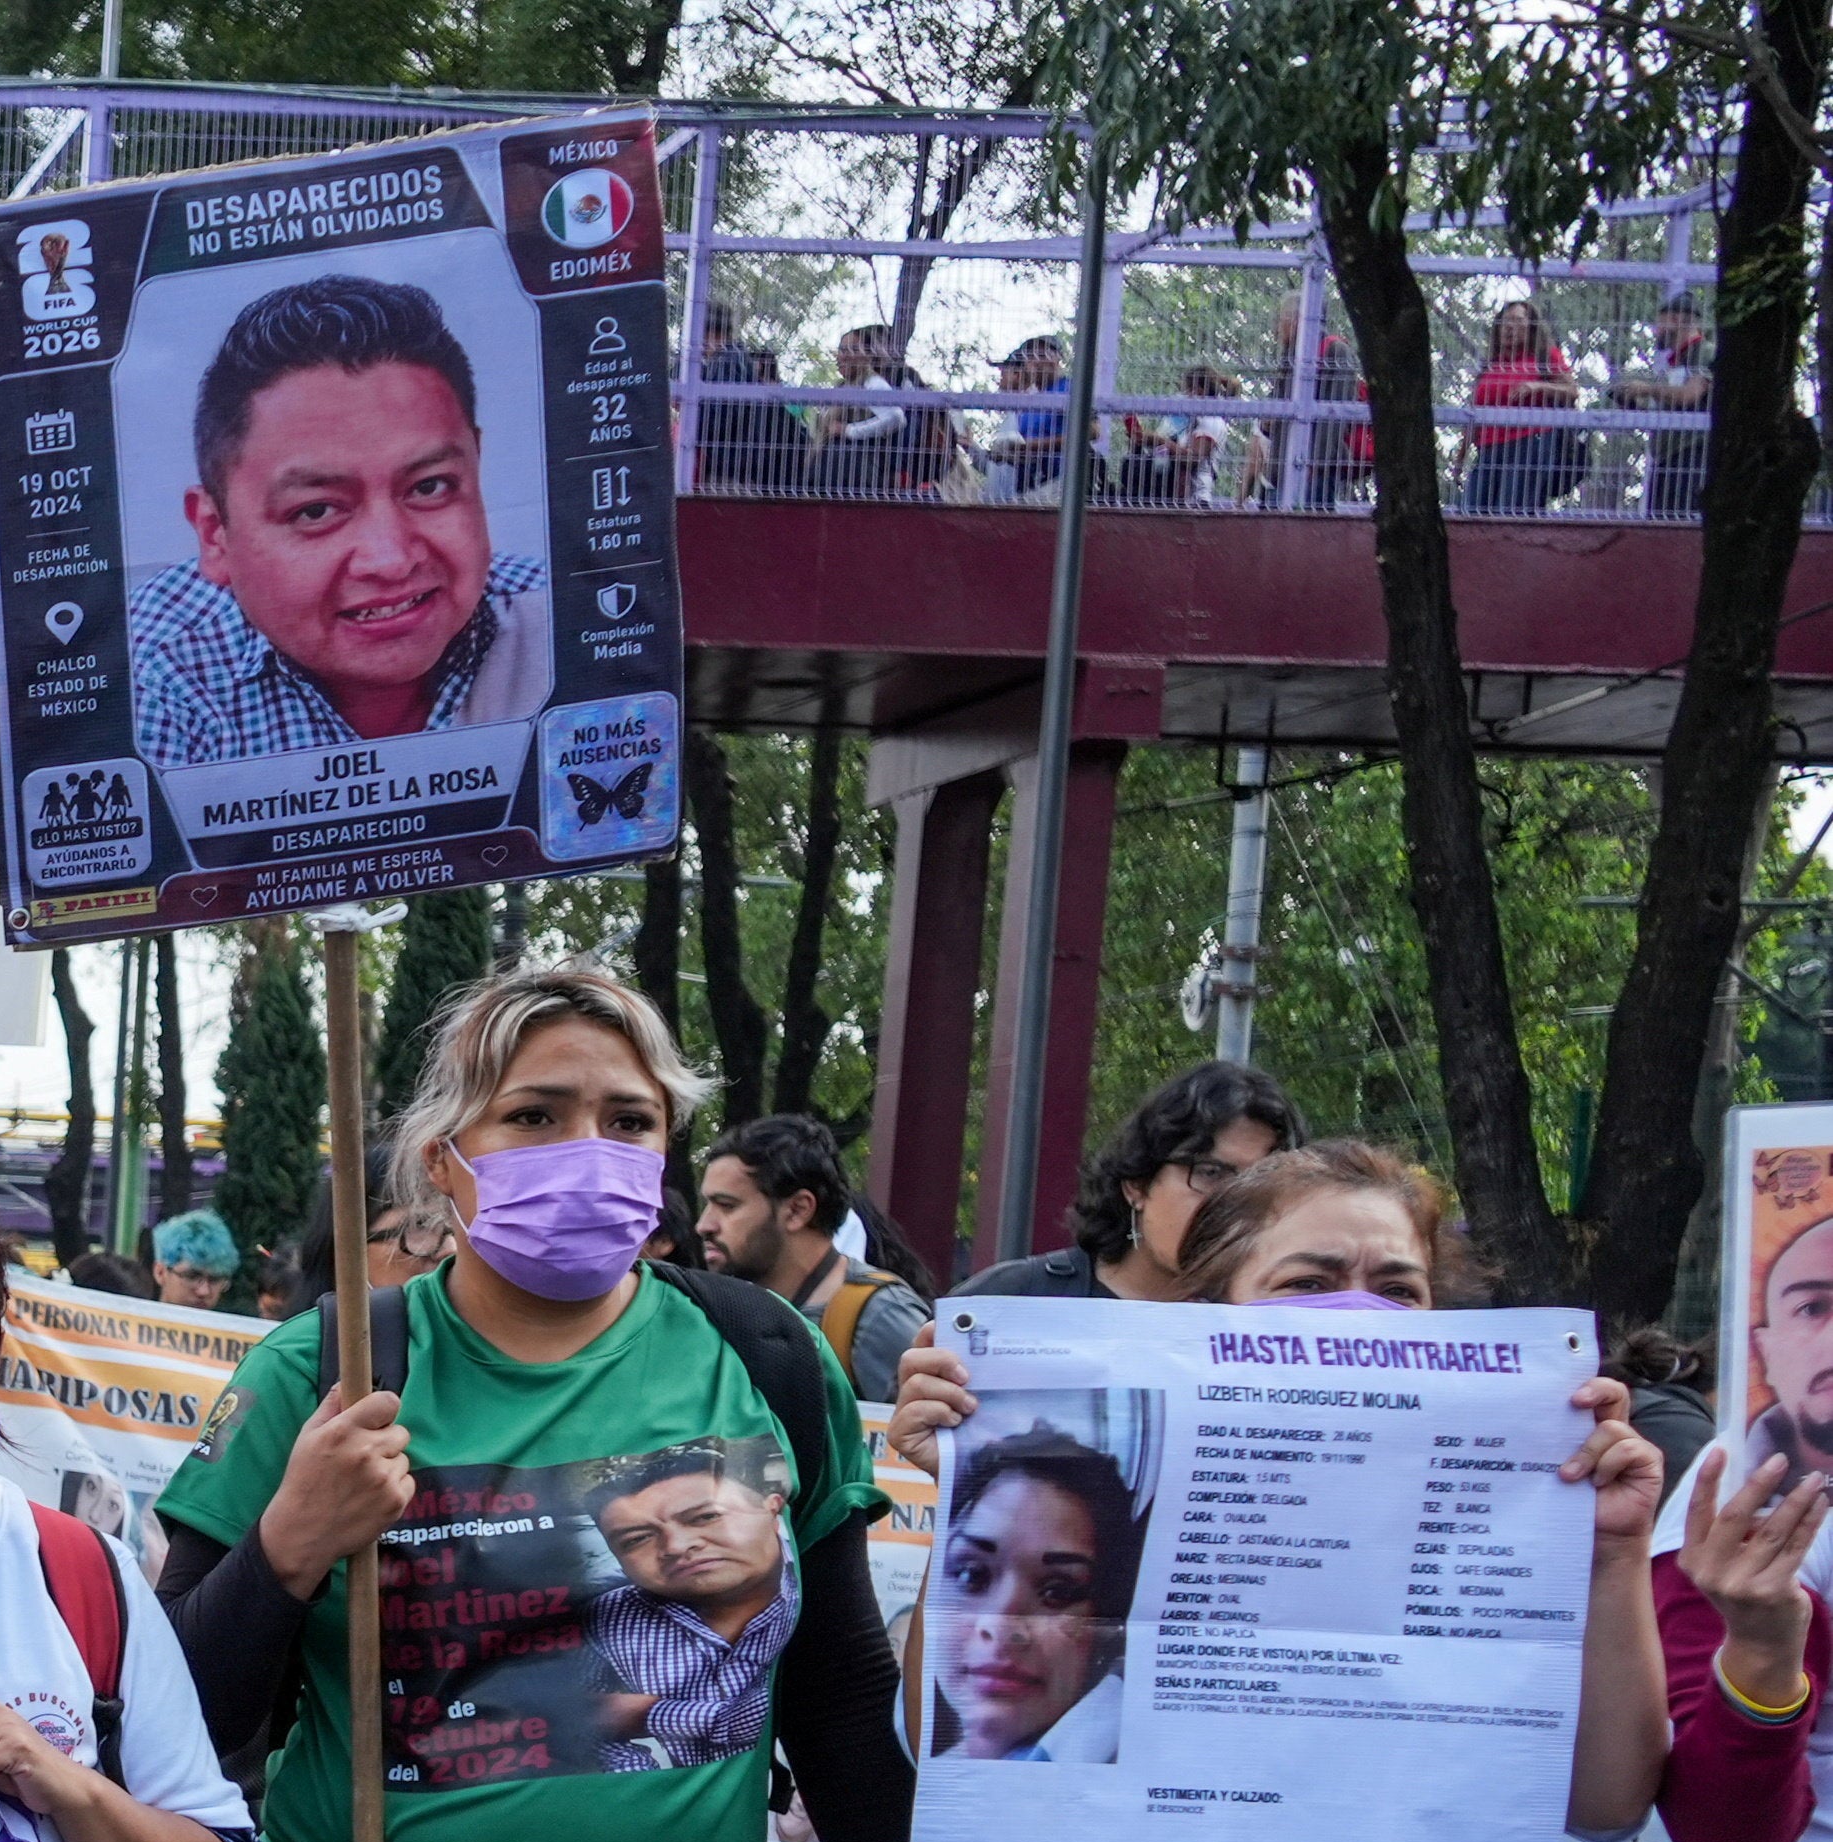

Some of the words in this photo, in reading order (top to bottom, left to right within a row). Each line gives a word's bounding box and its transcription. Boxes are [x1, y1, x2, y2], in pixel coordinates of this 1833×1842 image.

[548, 139, 618, 165] MÉXICO
[185, 165, 443, 230] DESAPARECIDOS
[188, 231, 221, 257] NO
[229, 217, 304, 250] ESTÁN
[312, 198, 444, 237] OLVIDADOS
[550, 249, 632, 282] EDOMÉX
[24, 327, 101, 359] 2026
[591, 393, 627, 422] 32
[589, 423, 632, 444] AÑOS
[18, 474, 43, 495] 19
[50, 466, 93, 490] OCT
[30, 494, 82, 519] 2024
[28, 547, 70, 564] FECHA
[74, 544, 91, 557] DE
[13, 557, 109, 584] DESAPARICIÓN
[581, 622, 655, 643] Complexión
[37, 654, 97, 676] CHALCO
[594, 642, 642, 661] Media
[28, 679, 84, 698] ESTADO
[89, 675, 108, 689] DE
[41, 697, 98, 718] MÉXICO
[574, 726, 599, 745] NO
[605, 717, 646, 741] MÁS
[313, 750, 385, 783] JOEL
[558, 738, 662, 768] AUSENCIAS
[202, 787, 340, 828] MARTÍNEZ
[346, 781, 383, 808] DE
[389, 777, 423, 803] LA
[429, 765, 499, 797] ROSA
[271, 815, 426, 853] DESAPARECIDO
[245, 878, 349, 911] AYÚDAME
[353, 877, 369, 895] A
[373, 863, 455, 891] VOLVER
[15, 1297, 130, 1345] PERSONAS
[1210, 1332, 1310, 1365] ¡HASTA
[1317, 1337, 1523, 1374] ENCONTRARLE!
[1197, 1385, 1263, 1403] LIZBETH
[1268, 1388, 1359, 1408] RODRIGUEZ
[1363, 1392, 1423, 1411] MOLINA
[388, 1764, 419, 1782] del
[426, 1743, 552, 1783] 2024
